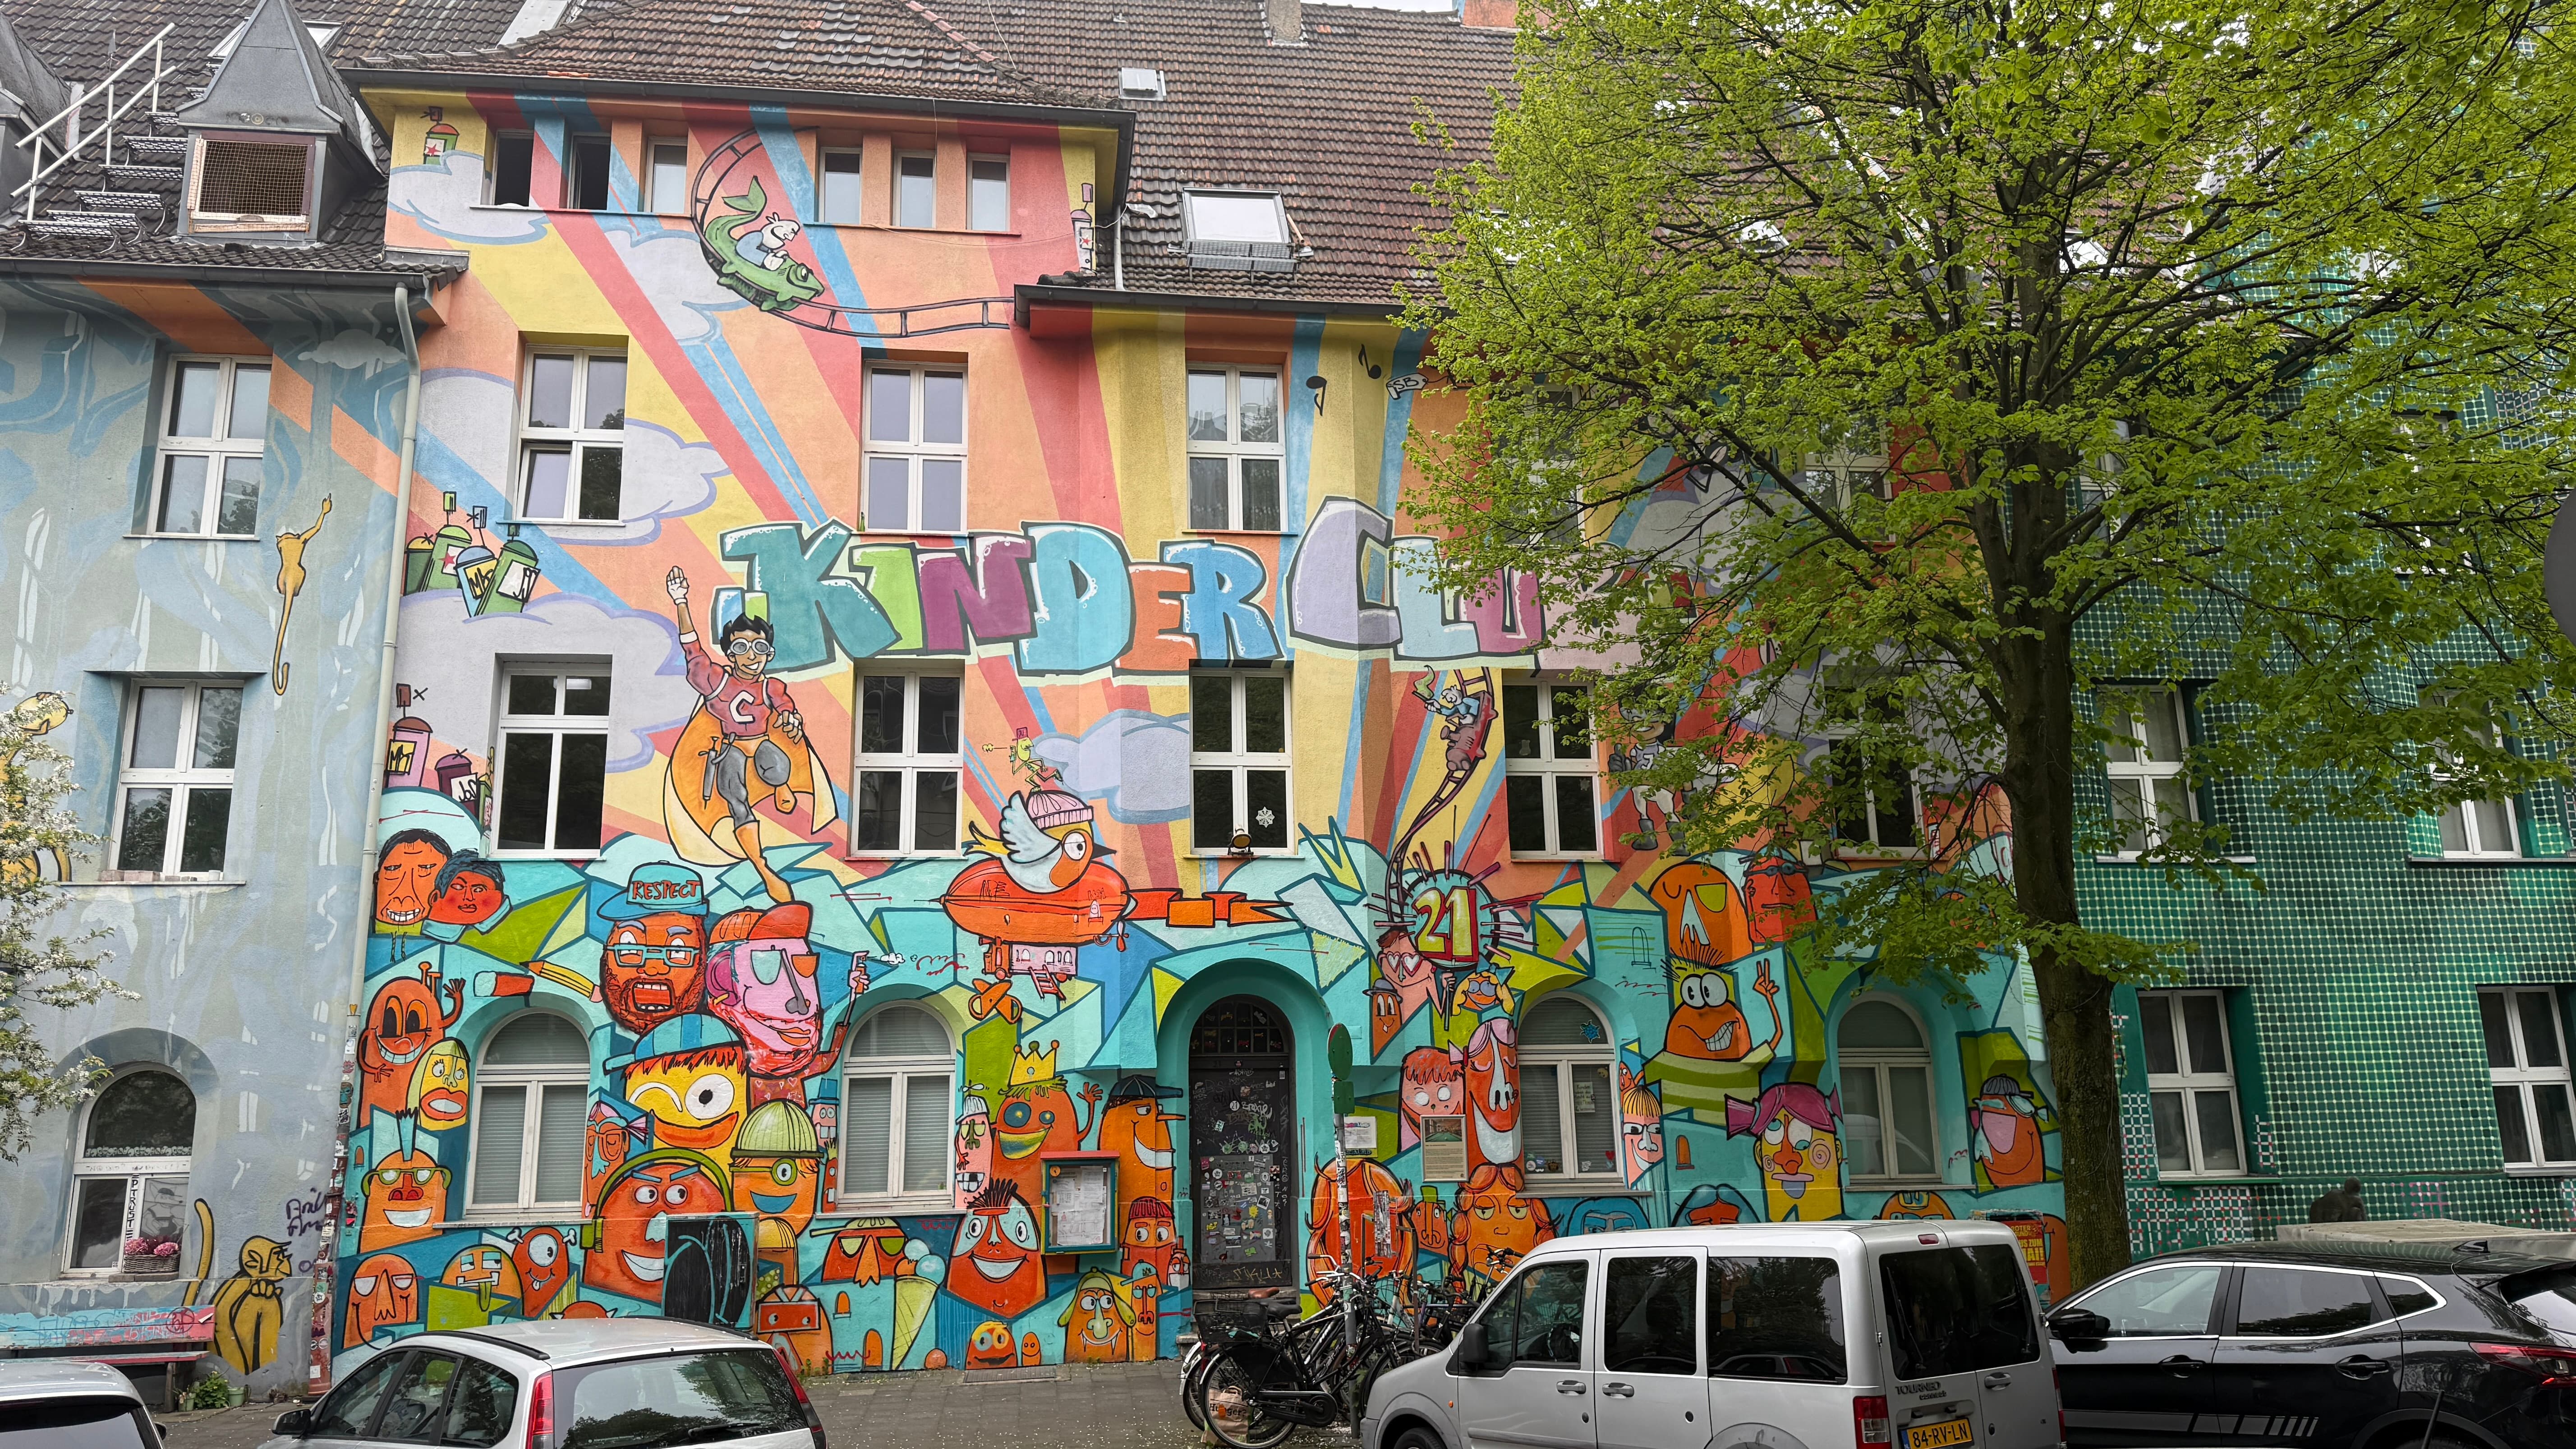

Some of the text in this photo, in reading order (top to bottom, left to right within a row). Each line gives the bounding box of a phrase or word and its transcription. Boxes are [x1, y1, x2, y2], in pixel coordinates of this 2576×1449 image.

[631, 879, 700, 900] RESPECT
[1412, 886, 1477, 962] 21
[2029, 1238, 2043, 1247] ZUM
[1895, 1381, 1941, 1395] TOURNEO
[1912, 1422, 1968, 1448] 84-RV-LN
